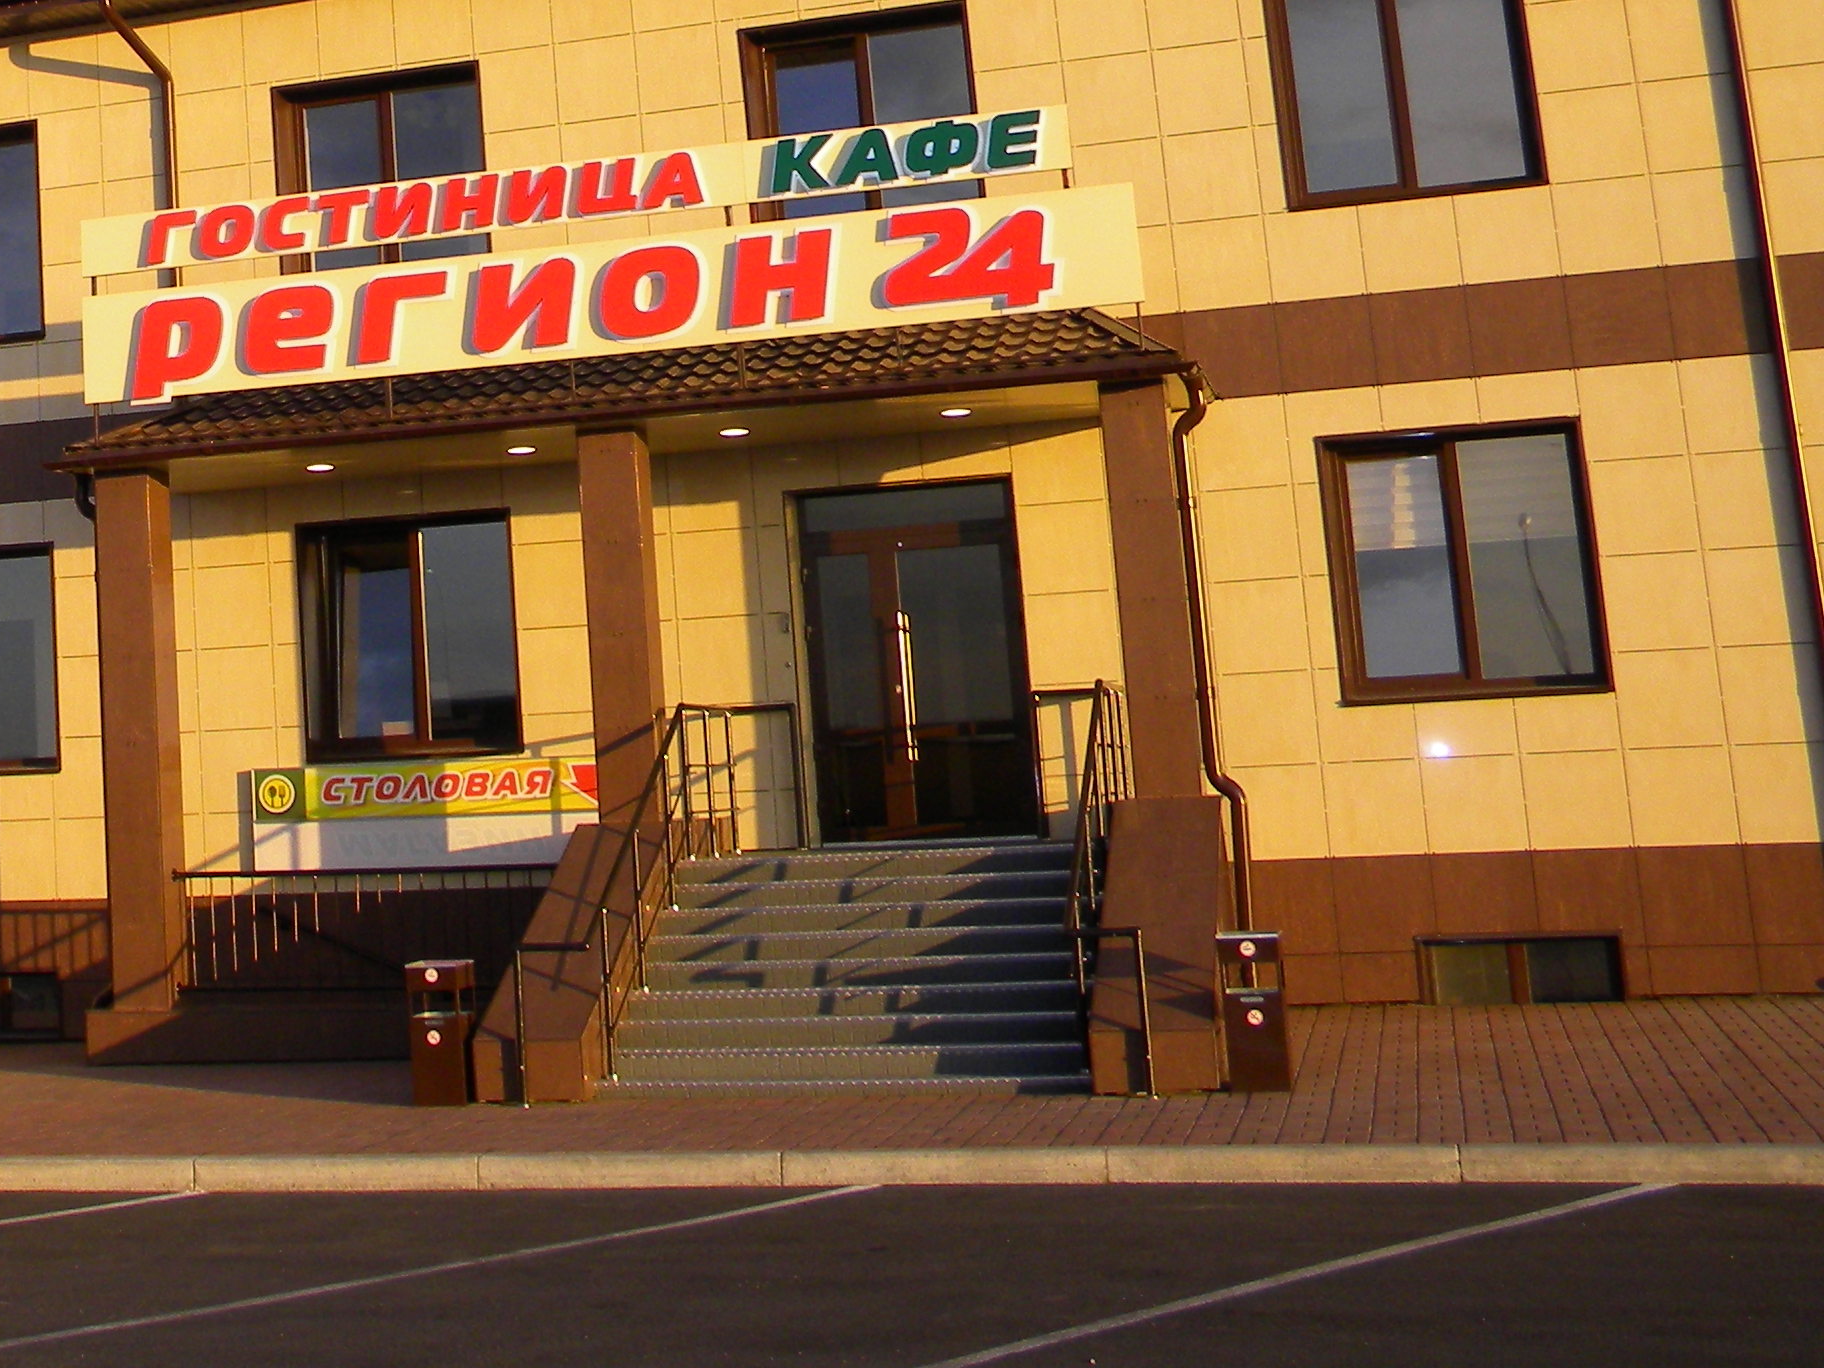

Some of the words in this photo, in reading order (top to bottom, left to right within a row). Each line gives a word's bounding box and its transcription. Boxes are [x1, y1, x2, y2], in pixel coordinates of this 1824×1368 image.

[146, 152, 704, 266] ГОСТИНИЦА
[770, 108, 1043, 195] КАФЕ
[883, 207, 1056, 308] 24
[321, 768, 554, 804] СТОЛОВАЯ
